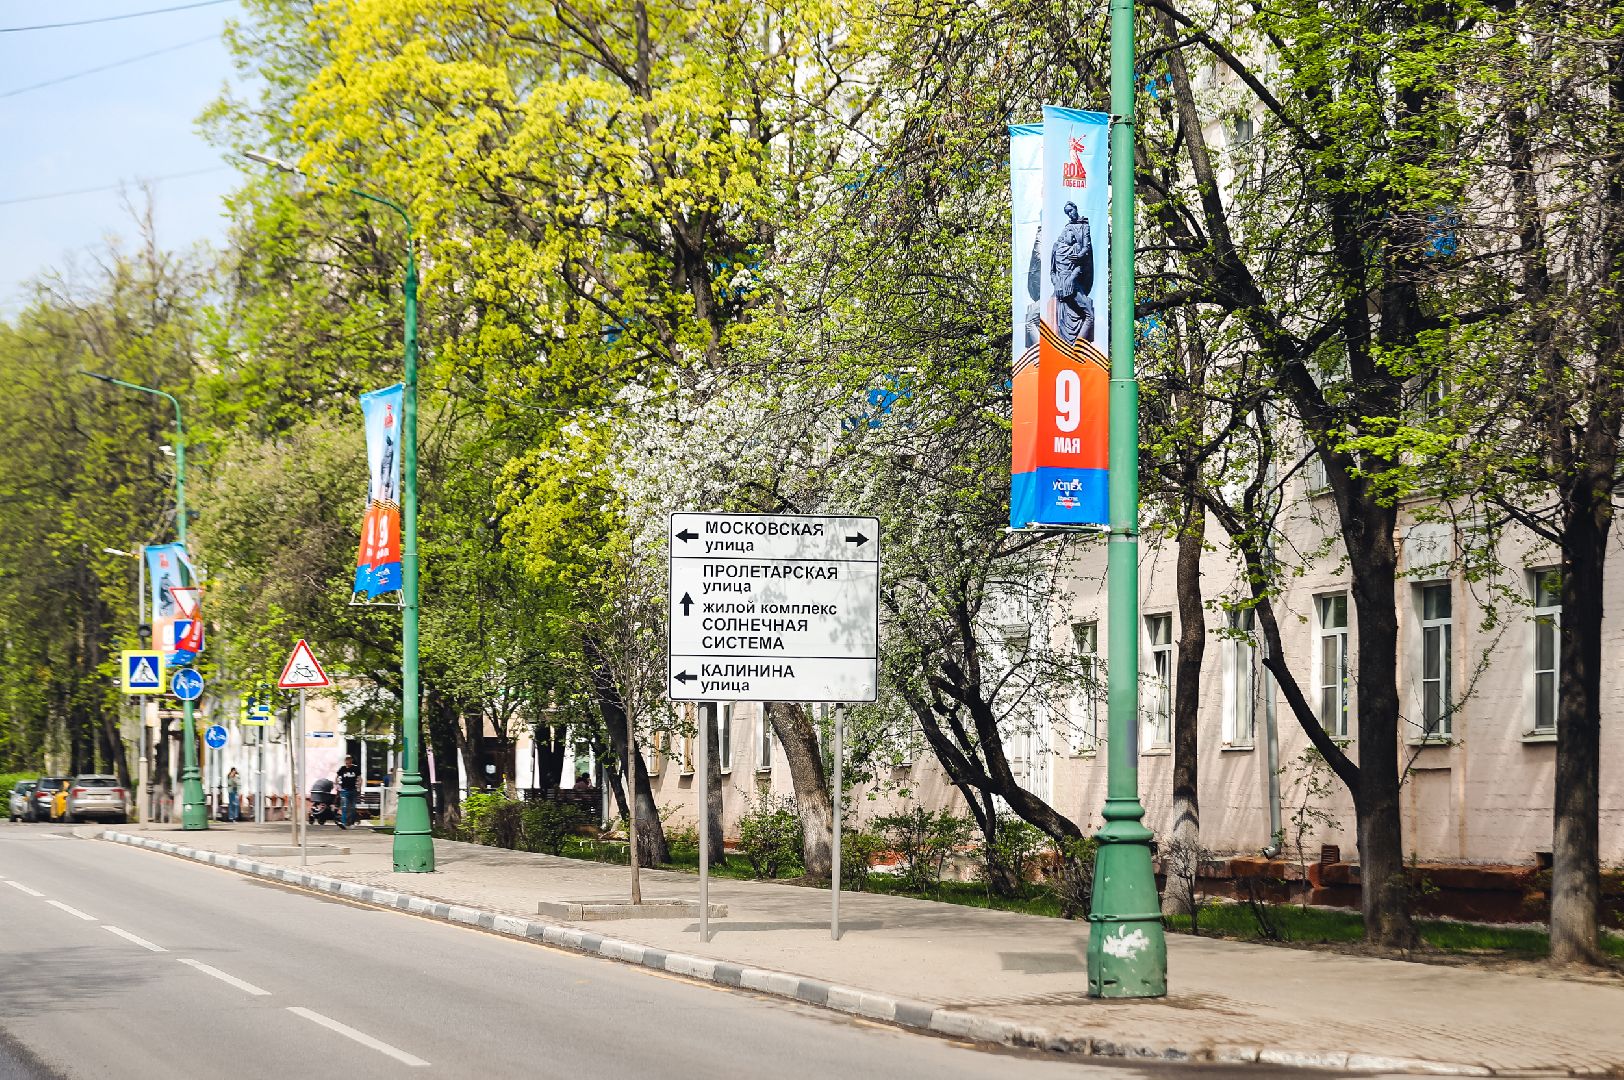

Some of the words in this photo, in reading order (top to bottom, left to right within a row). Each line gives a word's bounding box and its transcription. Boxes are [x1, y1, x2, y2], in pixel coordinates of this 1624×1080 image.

[1055, 369, 1081, 433] 9
[1053, 436, 1081, 454] МАЯ
[1052, 480, 1083, 491] УСПЕХ
[705, 521, 824, 537] МОСКОВСКАЯ
[705, 541, 754, 554] улица
[703, 565, 838, 580] ПРОЛЕТАРСКАЯ
[703, 583, 752, 595] улица
[703, 600, 755, 614] жилой
[761, 604, 837, 616] комплекс
[702, 618, 808, 632] СОЛНЕЧНАЯ
[702, 636, 785, 650] СИСТЕМА
[701, 664, 795, 678] КАЛИНИНА
[700, 681, 750, 694] улица
